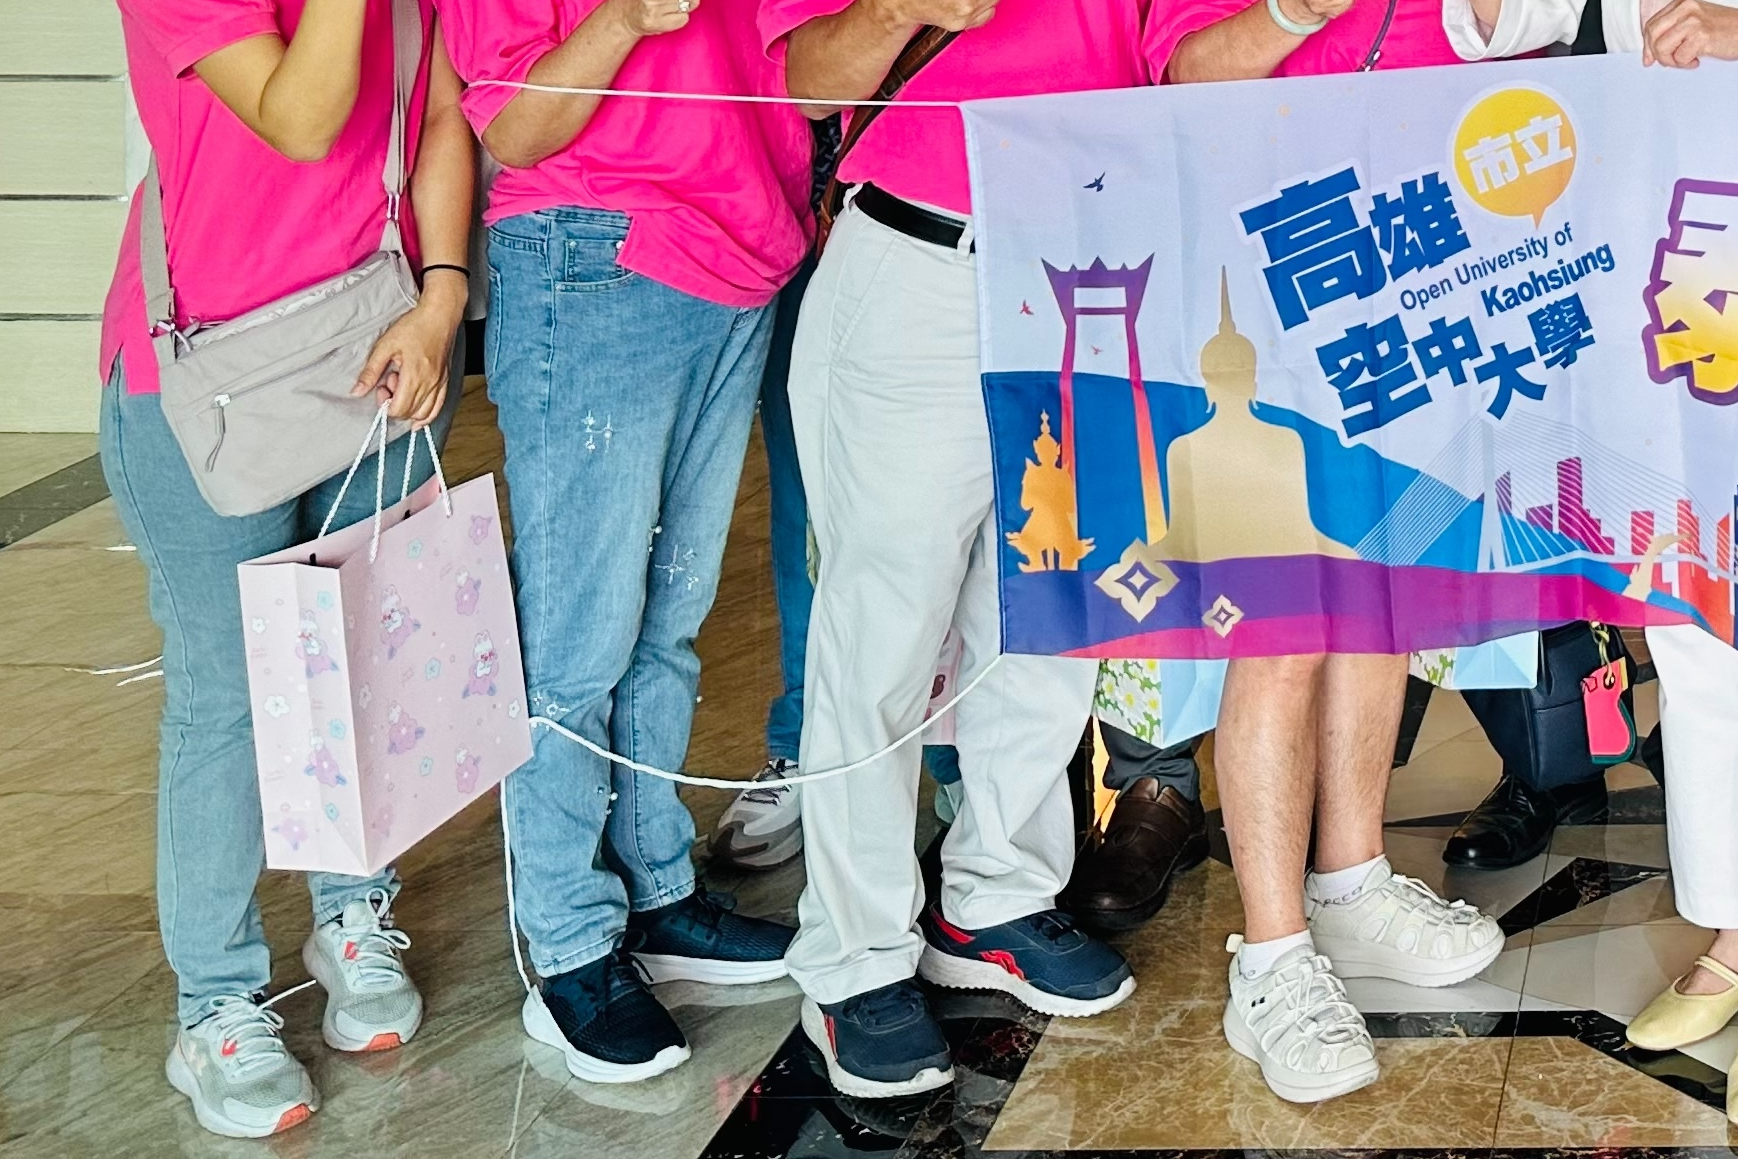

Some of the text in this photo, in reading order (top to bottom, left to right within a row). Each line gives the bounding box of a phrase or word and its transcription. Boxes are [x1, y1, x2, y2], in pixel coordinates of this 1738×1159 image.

[1463, 114, 1573, 194] 市立
[1240, 167, 1471, 331] 高雄
[1400, 221, 1574, 311] Open University of
[1480, 243, 1616, 317] Kaohsiung
[1316, 292, 1596, 440] 空中大學
